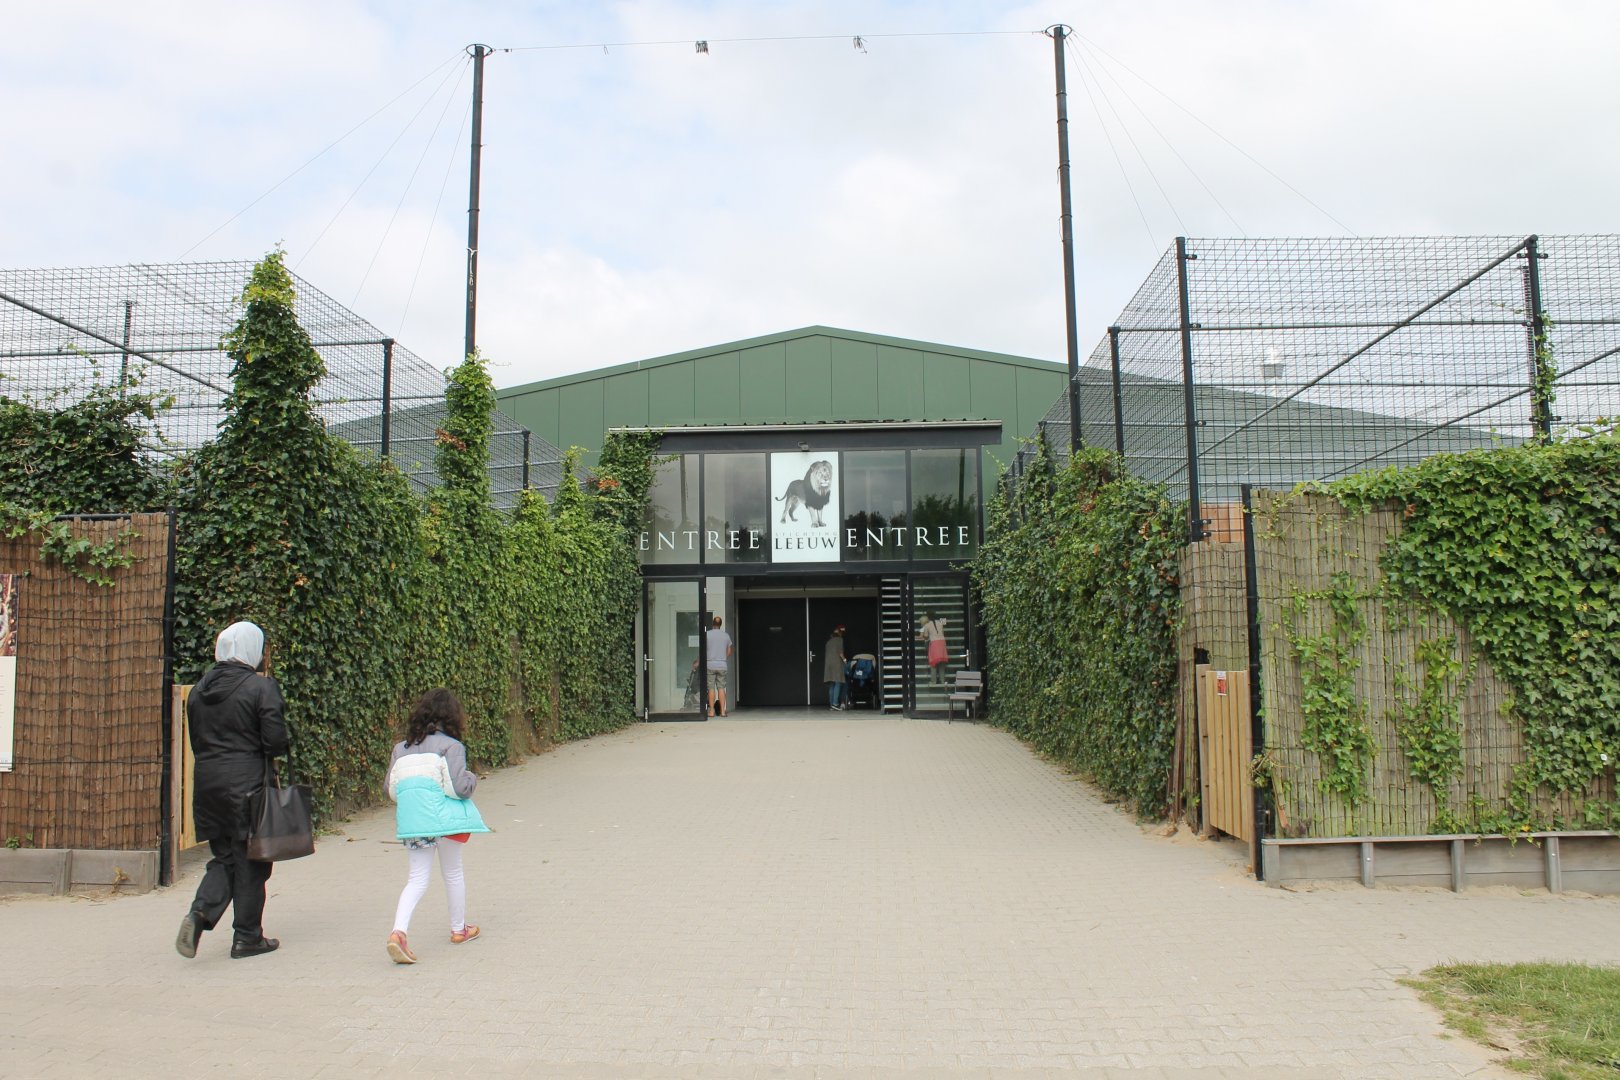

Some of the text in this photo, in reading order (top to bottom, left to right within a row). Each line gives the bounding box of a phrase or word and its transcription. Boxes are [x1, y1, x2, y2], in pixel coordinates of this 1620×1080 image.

[640, 530, 760, 551] ENTREE
[775, 537, 837, 550] LEEUW
[846, 526, 970, 548] ENTREE
